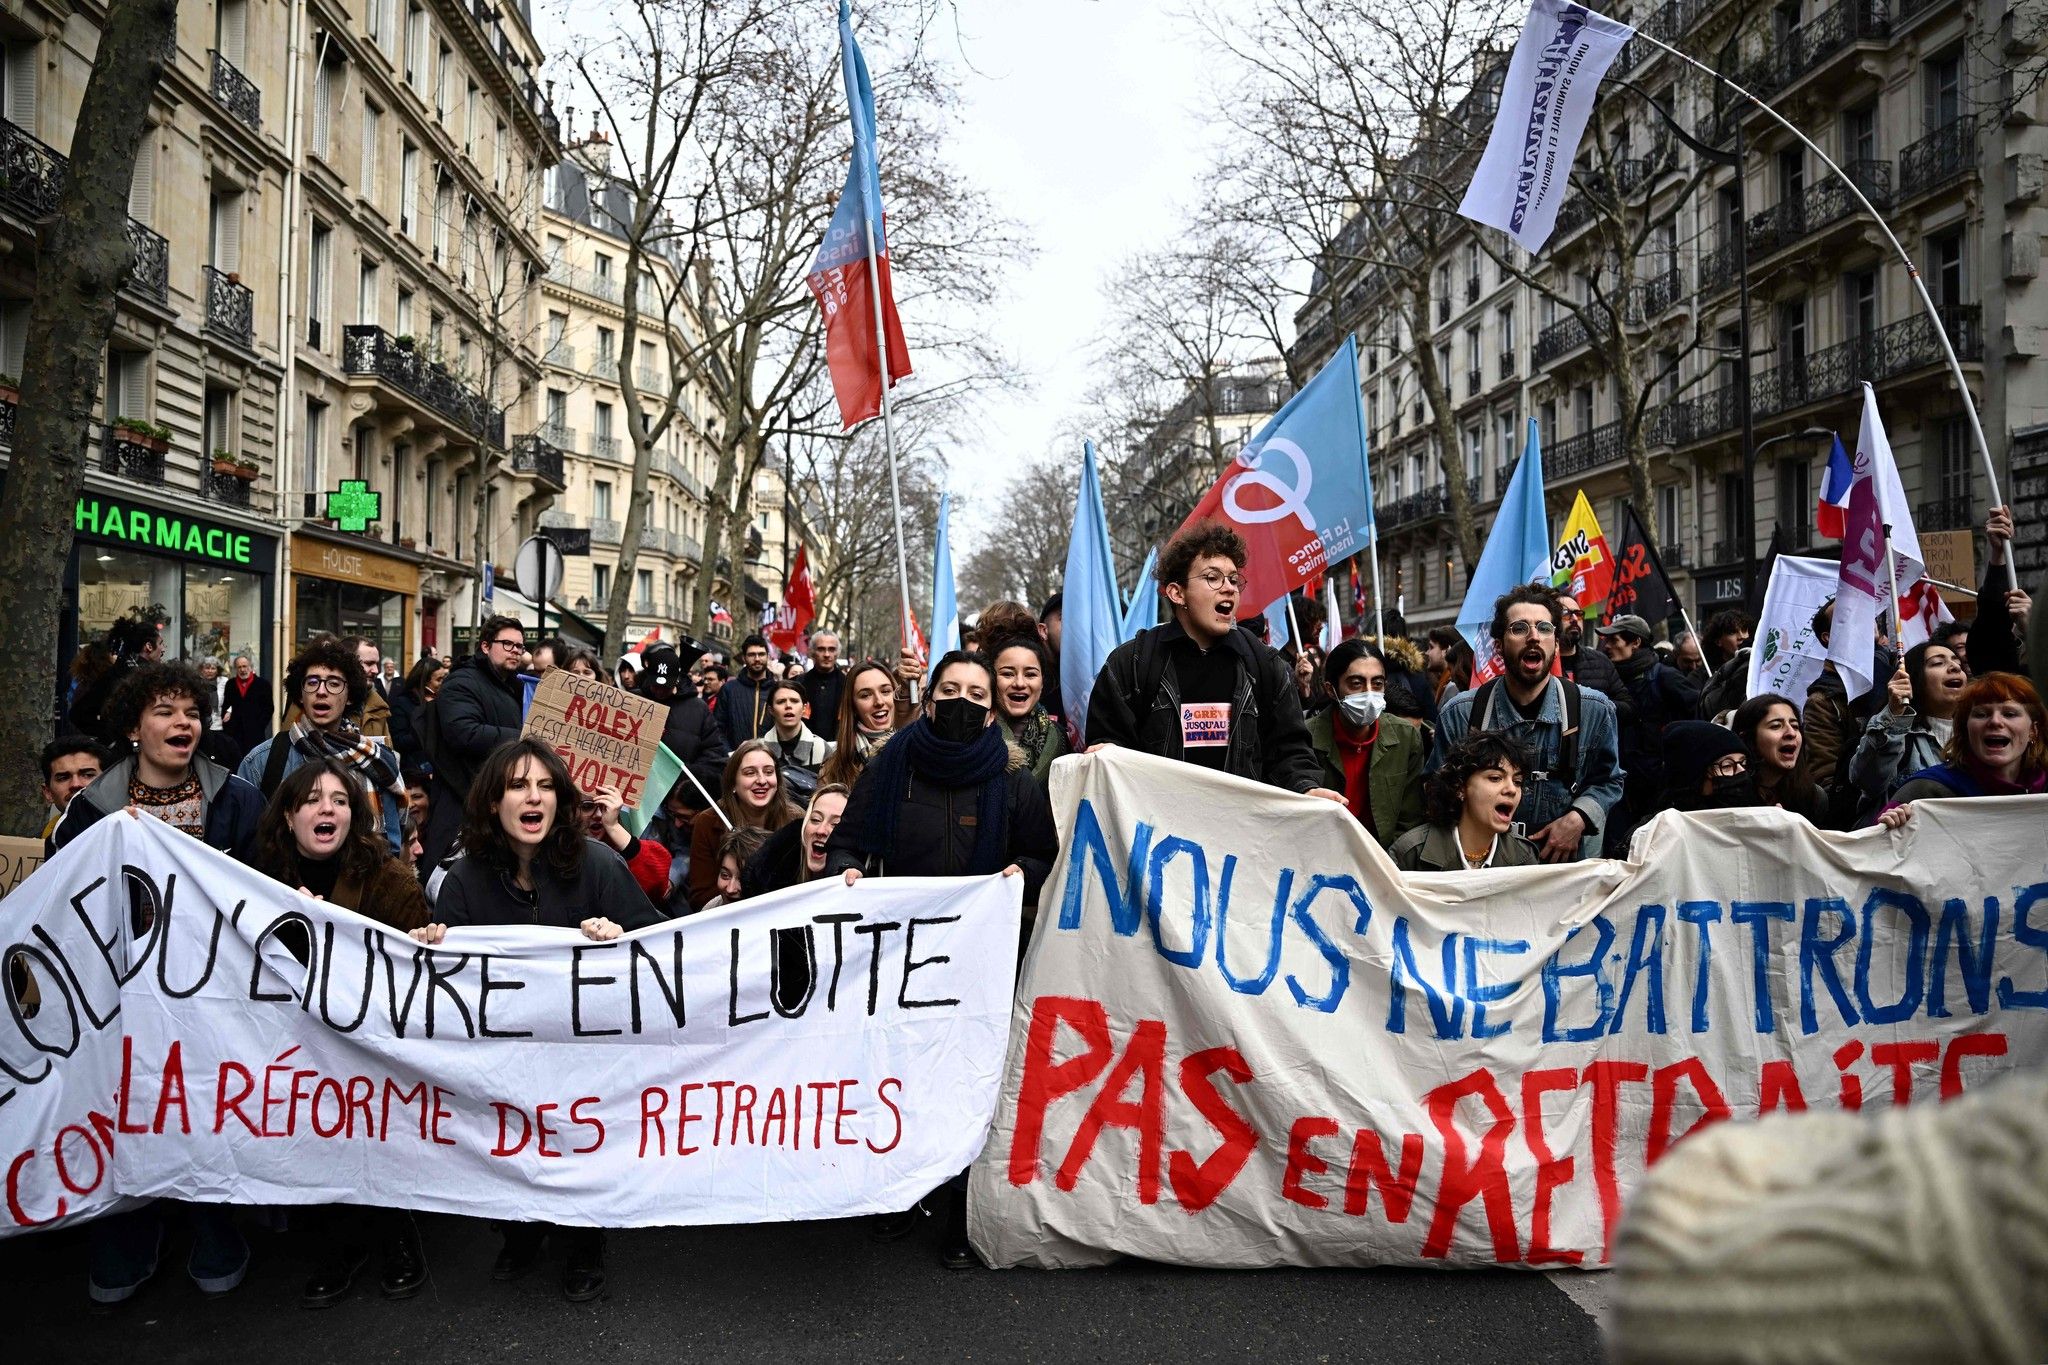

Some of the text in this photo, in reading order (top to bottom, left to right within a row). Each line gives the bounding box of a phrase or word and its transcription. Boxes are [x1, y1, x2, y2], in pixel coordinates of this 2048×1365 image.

[76, 498, 251, 564] HARMACIE
[1924, 548, 1954, 562] TRON
[1715, 578, 1742, 600] LES
[560, 674, 656, 721] REGARDE TA
[564, 695, 643, 745] ROLEX
[529, 714, 568, 743] C'EST
[627, 747, 641, 771] LA
[121, 864, 223, 999] DU
[571, 930, 686, 1037] EN
[728, 912, 963, 1028] LUTTE
[1058, 798, 2048, 1044] NOUS NE BATTRONS
[118, 1035, 191, 1136] LA
[213, 1044, 457, 1146] RÉFORME
[489, 1096, 606, 1159] DES
[638, 1078, 903, 1159] RETRAITES
[1008, 995, 1260, 1215] PAS
[1281, 1117, 1424, 1224] EN
